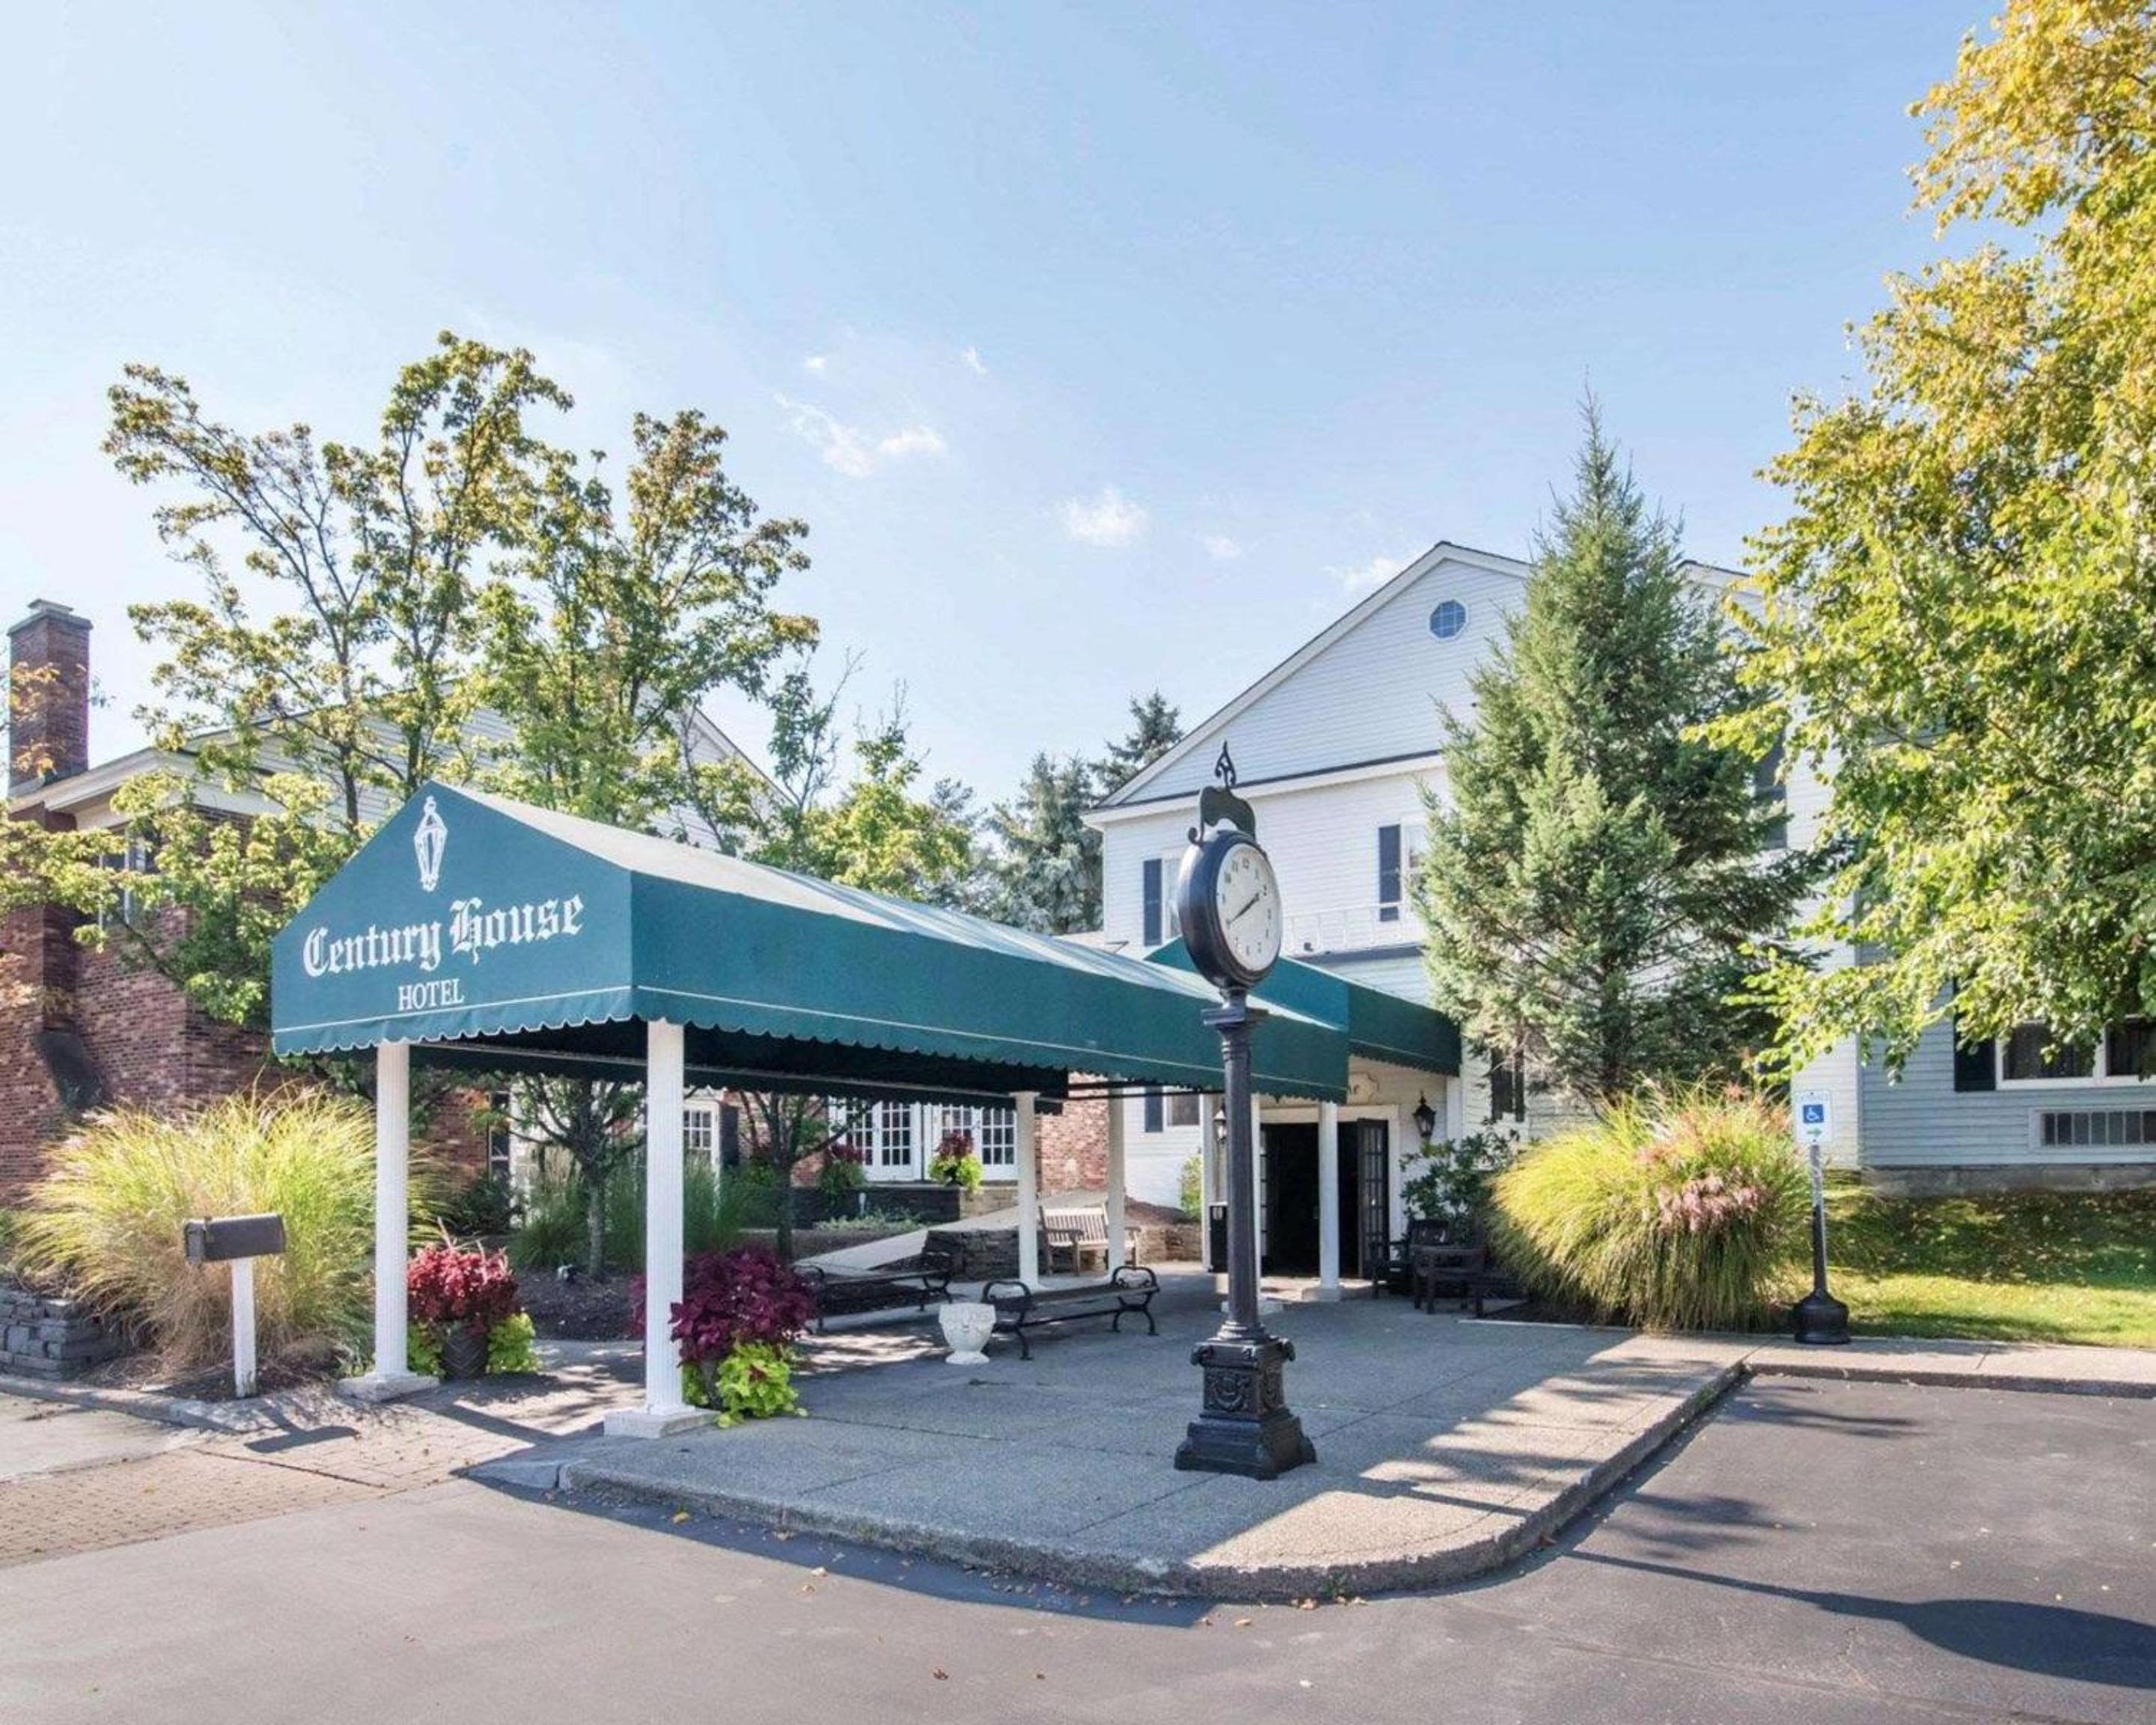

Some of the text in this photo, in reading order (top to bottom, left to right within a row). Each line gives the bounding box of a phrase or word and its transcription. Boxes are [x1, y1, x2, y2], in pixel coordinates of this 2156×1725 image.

[302, 894, 585, 978] Century House
[398, 978, 465, 1011] HOTEL
